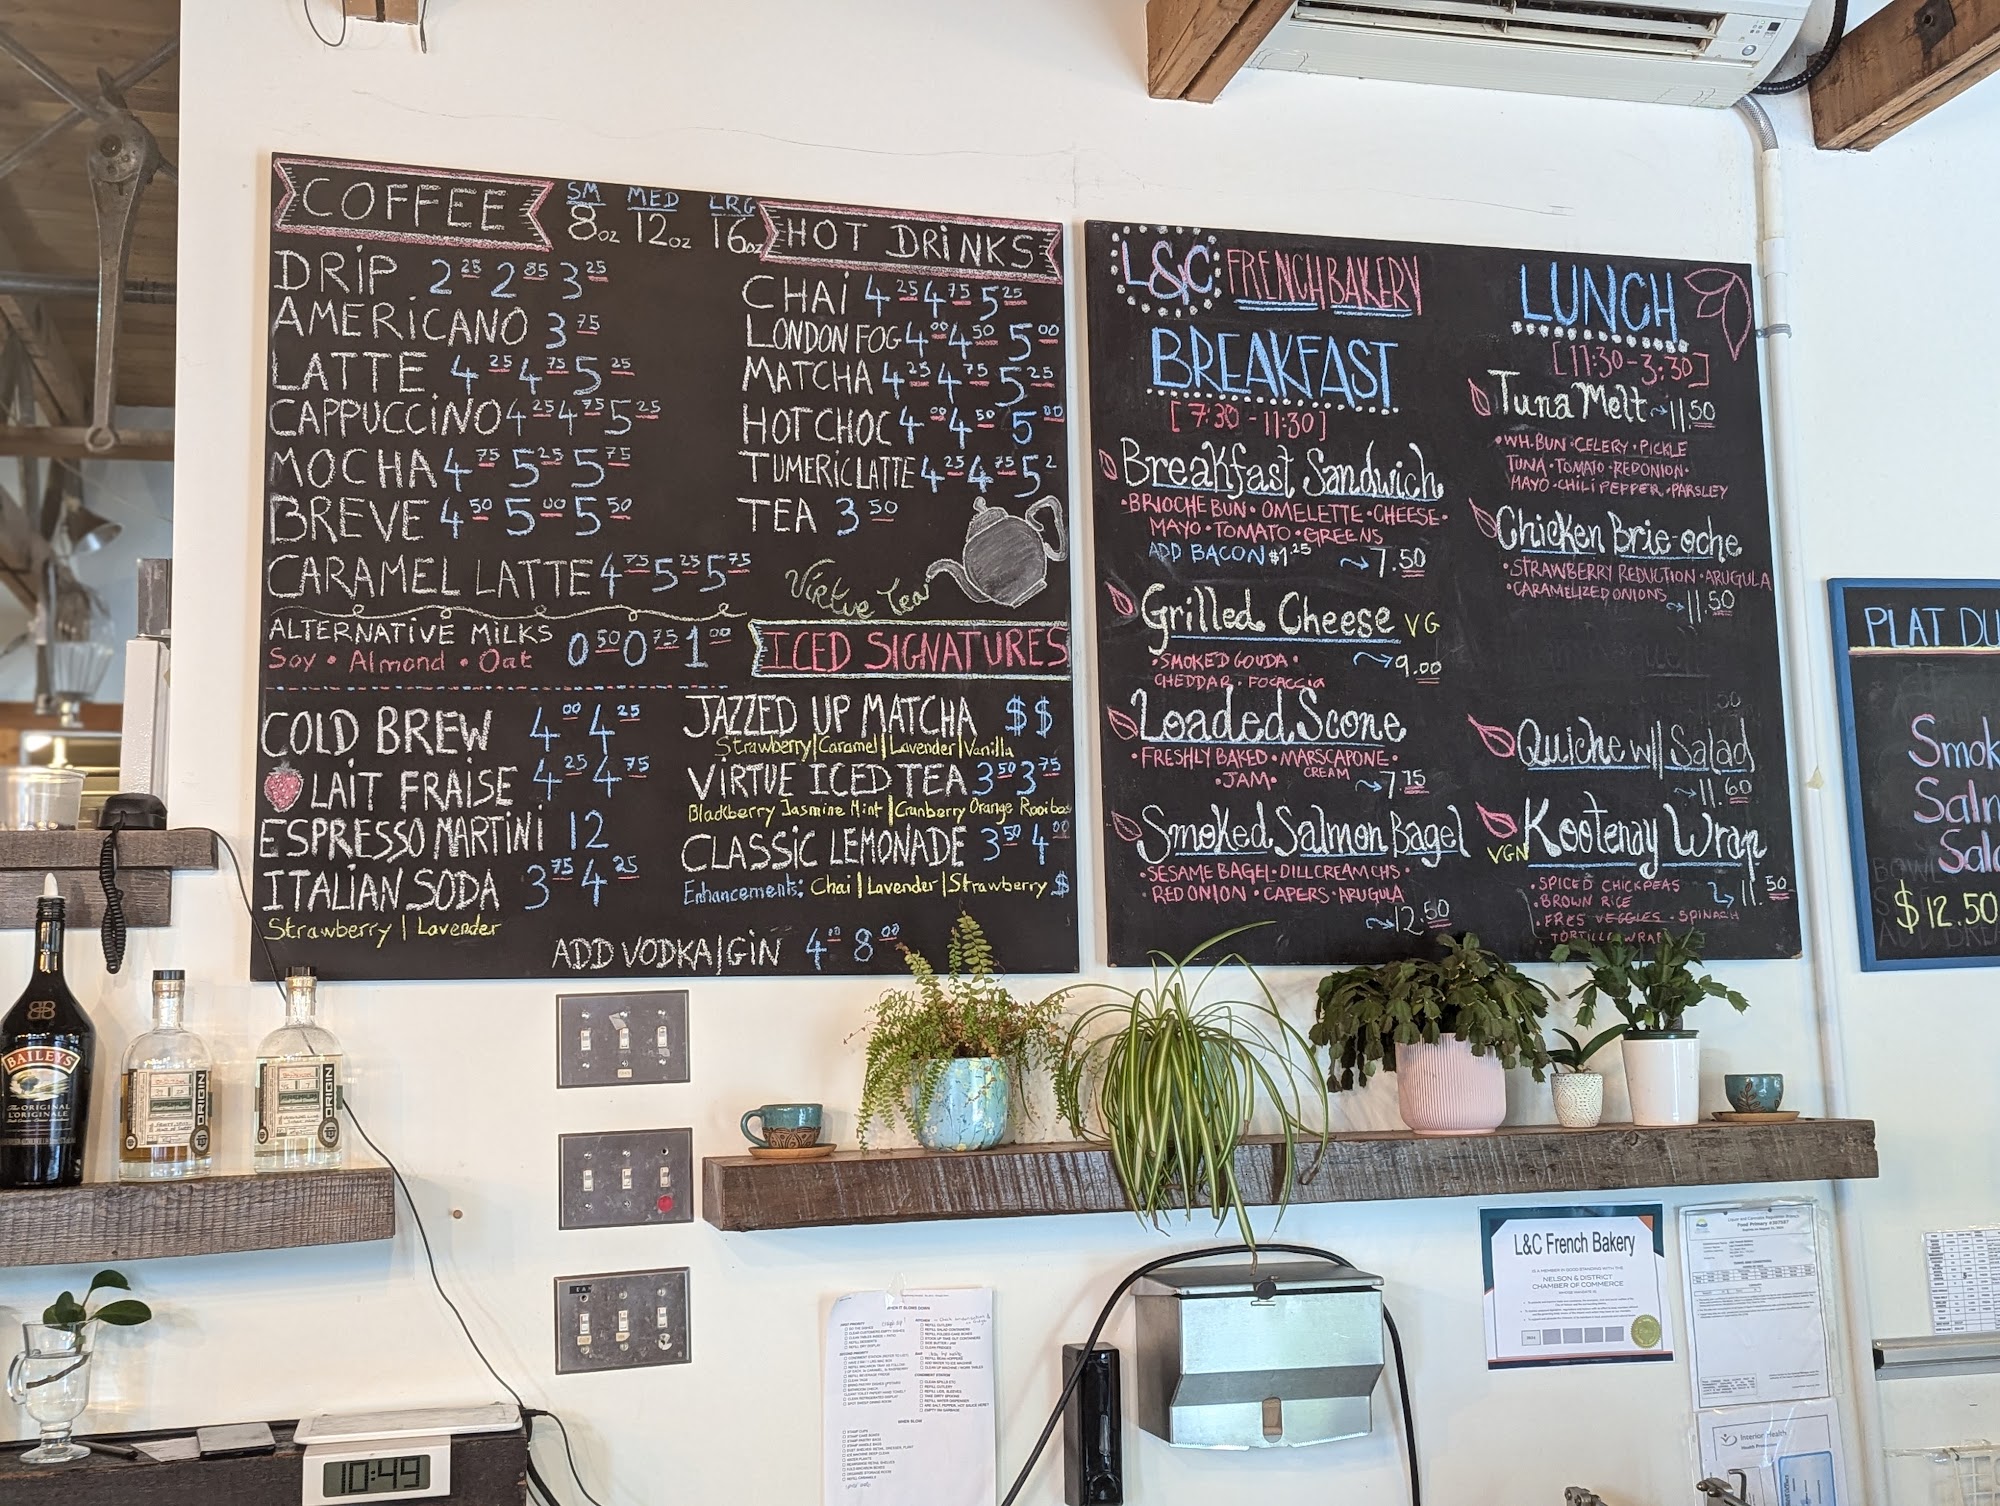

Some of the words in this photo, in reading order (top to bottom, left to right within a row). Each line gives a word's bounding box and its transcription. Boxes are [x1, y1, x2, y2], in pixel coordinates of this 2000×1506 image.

[302, 177, 508, 231] COFFEE
[567, 181, 600, 202] SM
[628, 187, 679, 208] MED
[710, 196, 756, 213] LRG
[788, 218, 868, 251] HOT
[1122, 240, 1213, 305] L&C
[1227, 249, 1325, 310] FRENCH
[1327, 256, 1422, 315] BAKERY
[1521, 262, 1677, 343] LUNCH
[747, 314, 849, 352] LONDON
[856, 326, 901, 353] FOG
[271, 352, 427, 393] LATTE
[742, 356, 873, 394] MATCHA
[1152, 325, 1398, 407] BREAKFAST
[1487, 369, 1574, 419] Tuna
[1571, 381, 1647, 423] Melt
[1507, 455, 1547, 477] TUNA
[1555, 458, 1604, 475] TOMATO
[1575, 437, 1628, 454] CELERY
[1640, 439, 1688, 458] PICKLE
[270, 449, 437, 488] MOCHA
[1121, 438, 1295, 499] Breakfast
[1303, 441, 1443, 499] Sandwich
[1511, 475, 1549, 492] MAYO
[1600, 482, 1663, 497] PEPPER
[1672, 484, 1728, 499] PARSLEY
[270, 495, 429, 544] BREVE
[737, 497, 817, 533] TEA
[1128, 493, 1207, 513] BRIOCHE
[1212, 498, 1246, 517] BUN
[1262, 502, 1363, 523] OMELETTE
[1373, 505, 1438, 524] CHEESE
[1150, 518, 1200, 535] MAYO
[1215, 521, 1290, 542] TOMATO
[1304, 528, 1383, 545] GREENS
[1496, 505, 1605, 554] Chicken
[1149, 542, 1182, 559] ADD
[1191, 544, 1265, 565] BACON
[267, 555, 461, 599] CARAMEL
[476, 559, 593, 599] LATTE
[1509, 557, 1612, 582] STRAWBERRY
[1619, 564, 1695, 583] REDUCTION
[1706, 570, 1771, 590] ARUGULA
[1513, 581, 1609, 599] CARAMELIZED
[1612, 588, 1666, 602] ONIONS
[1141, 583, 1265, 655] Grilled
[1279, 592, 1396, 637] Cheese
[1865, 607, 1945, 648] PLAT
[269, 650, 316, 673] Soy
[349, 651, 445, 673] Almond
[479, 648, 532, 673] Oat
[762, 629, 851, 672] ICED
[865, 627, 1069, 672] SIGNATURES
[1160, 651, 1229, 671] SMOKED
[1234, 651, 1288, 669] GOUDA
[261, 709, 360, 757] COLD
[378, 706, 493, 756] BREW
[684, 694, 797, 738] JAZZED
[812, 695, 850, 736] UP
[861, 693, 977, 739] MATCHA
[1131, 684, 1294, 745] Loaded
[1297, 687, 1407, 742] Scone
[1141, 746, 1209, 769] FRESHLY
[1216, 749, 1268, 766] BAKED
[1280, 750, 1389, 768] MARSCAPONE
[1517, 719, 1625, 767] Quiche
[1671, 717, 1755, 775] Salad
[809, 763, 892, 796] ICED
[897, 763, 968, 797] TEA
[1223, 772, 1268, 789] JAM
[1304, 767, 1350, 781] CREAM
[780, 799, 845, 816] Jasmine
[970, 798, 1013, 825] Orange
[260, 817, 426, 863] ESPRESSO
[830, 823, 966, 868] LEMONADE
[1137, 801, 1273, 864] Smoked
[1275, 805, 1388, 857] Salmon
[1390, 805, 1471, 868] Bagel
[1488, 843, 1528, 863] VGN
[1524, 791, 1658, 879] Kootenay
[1663, 803, 1767, 882] Wrap
[406, 868, 500, 912] SODA
[1148, 864, 1213, 883] SESAME
[1218, 862, 1275, 884] BAGEL
[1539, 875, 1593, 890] SPICED
[1602, 876, 1680, 893] CHICKPEAS
[1187, 885, 1247, 903] ONION
[1264, 886, 1329, 903] CAPERS
[1339, 886, 1405, 906] ARUGULA
[1540, 894, 1592, 908] BROWN
[264, 919, 392, 949] Strawberry
[418, 917, 502, 938] Lavender
[552, 938, 614, 969] ADD
[7, 1050, 75, 1068] BAILEYS
[197, 1074, 205, 1124] ORIGIN
[325, 1067, 333, 1117] ORIGIN
[1514, 1233, 1542, 1255] L&C
[1547, 1231, 1588, 1254] French
[1593, 1231, 1635, 1257] Bakery
[341, 1456, 420, 1493] 10:49
